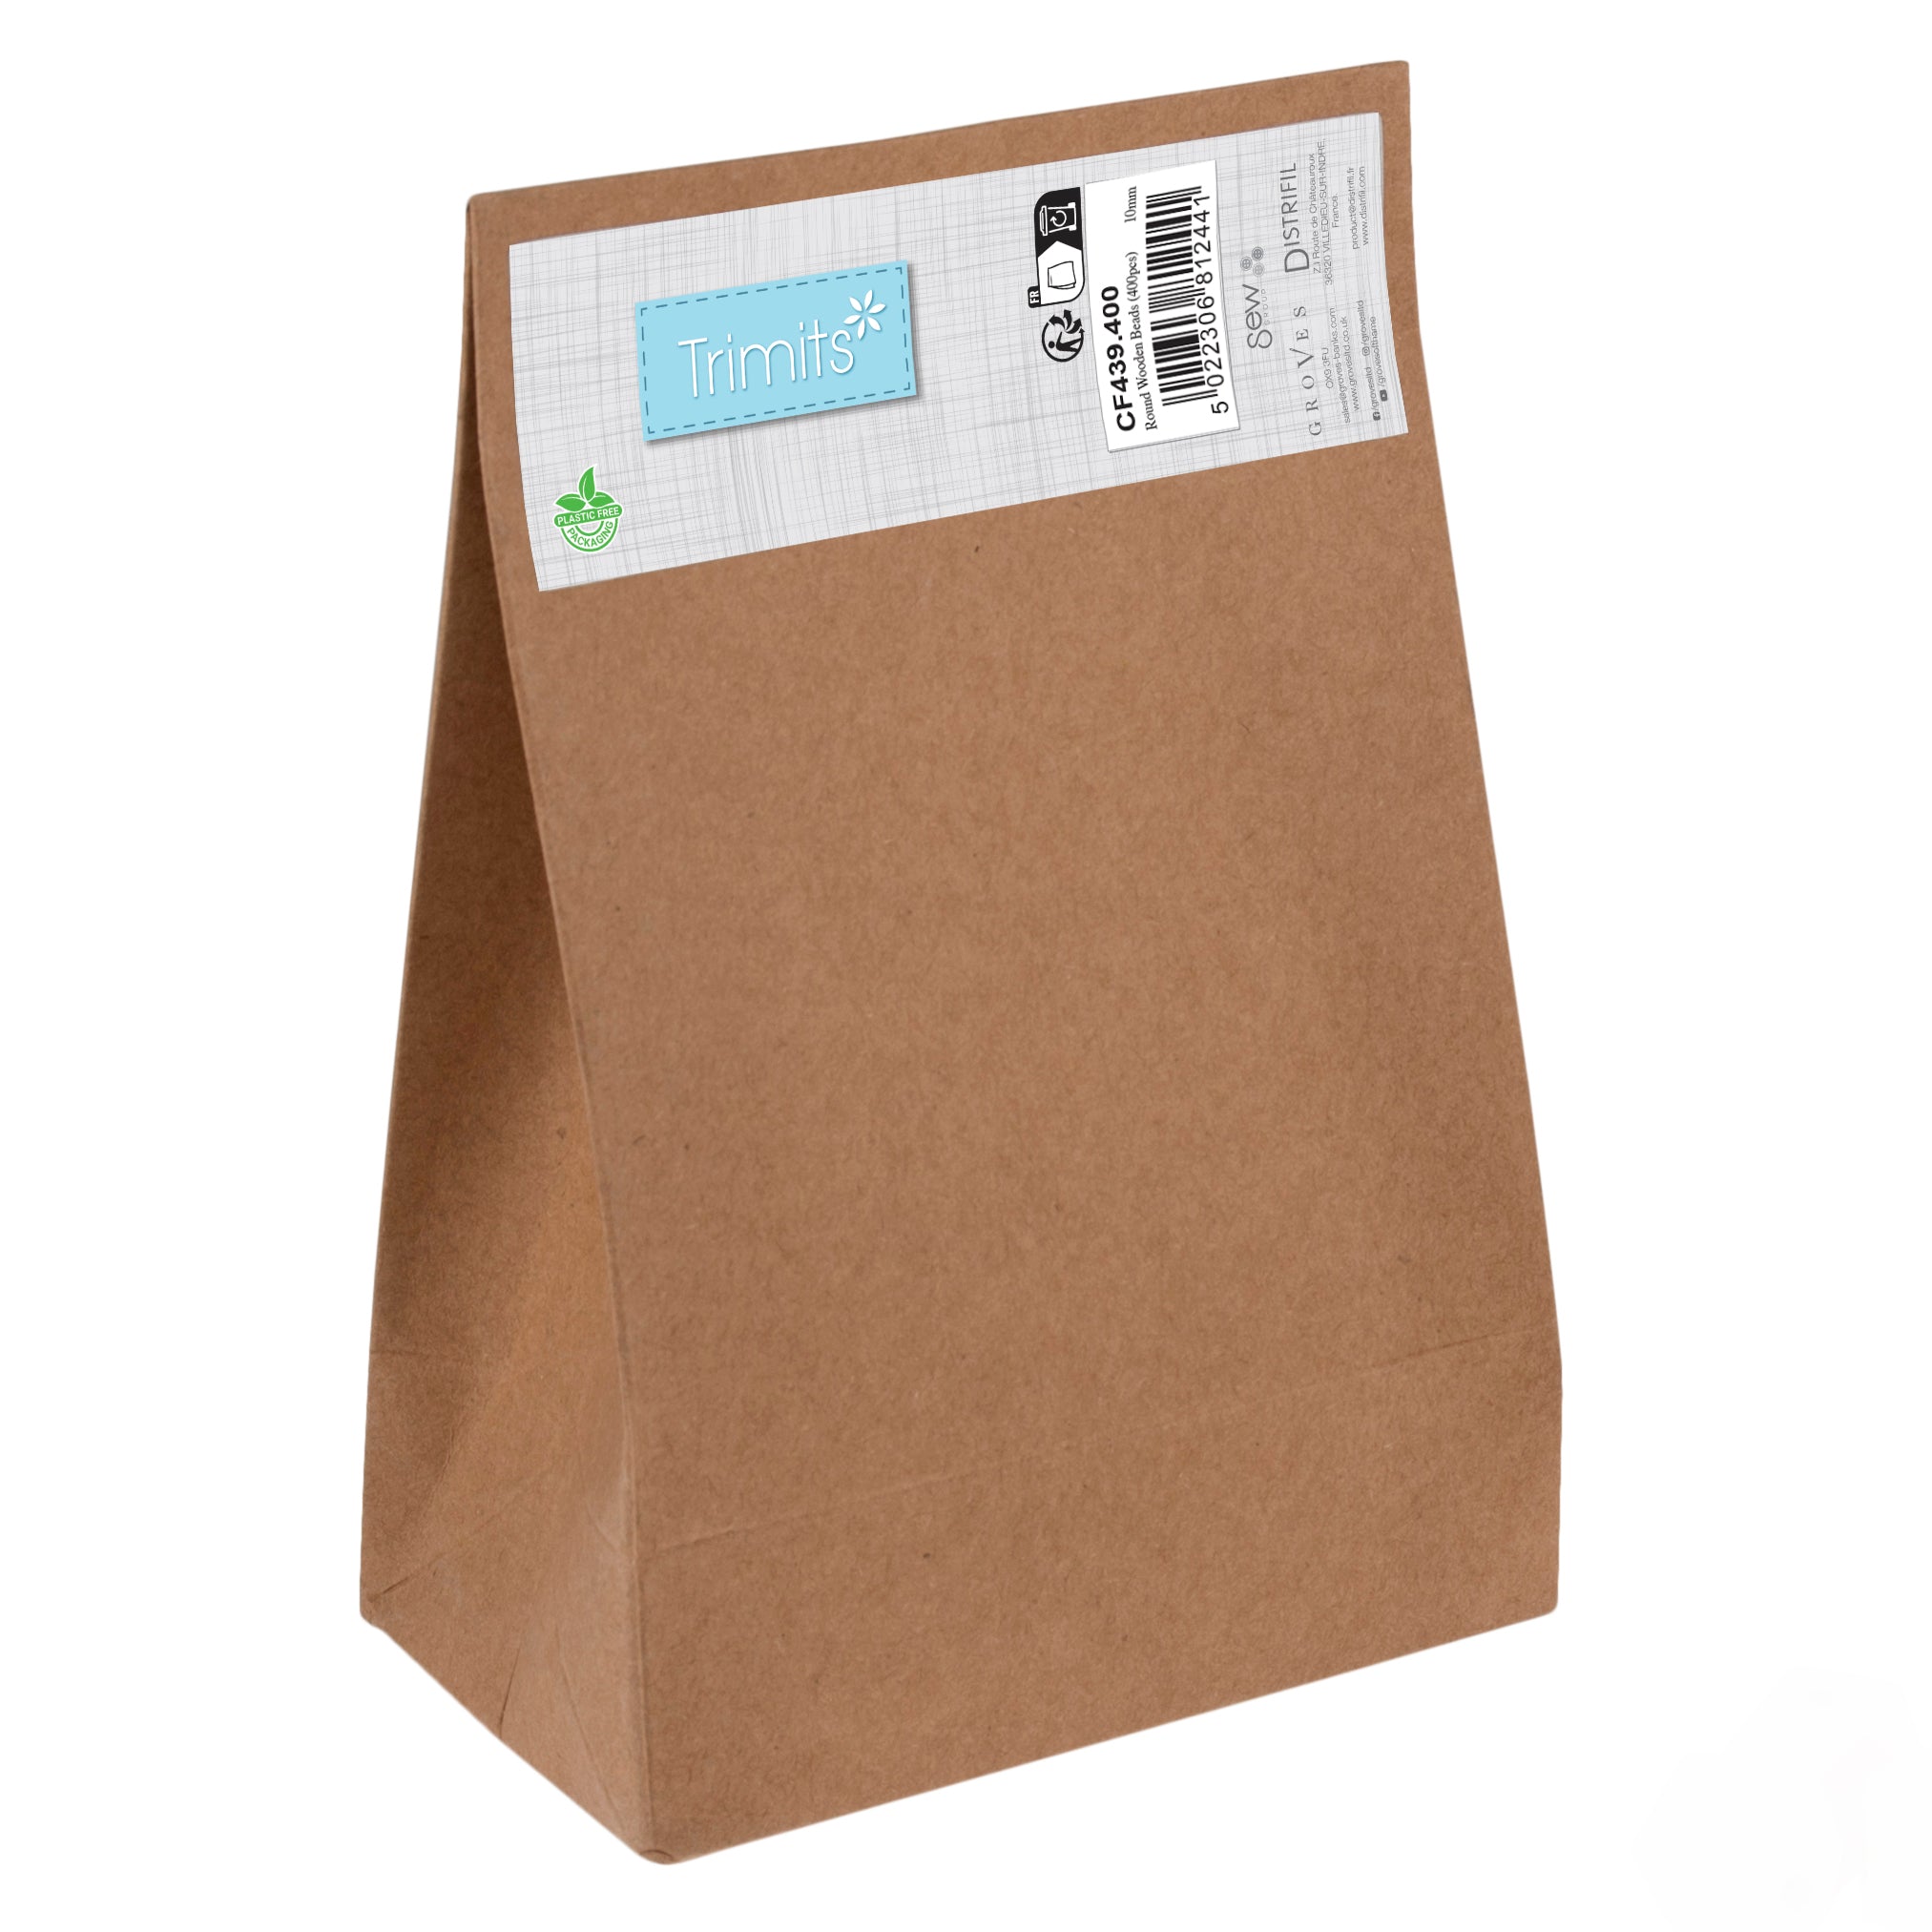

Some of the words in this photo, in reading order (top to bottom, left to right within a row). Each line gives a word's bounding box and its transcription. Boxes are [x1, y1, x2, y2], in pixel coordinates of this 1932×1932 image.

[1124, 186, 1136, 223] 10mm
[1311, 216, 1319, 228] de
[1194, 196, 1213, 285] 812441
[1126, 251, 1139, 303] (400pcs)
[1029, 290, 1040, 303] FR
[1261, 289, 1271, 326] GROUP
[1129, 304, 1142, 341] Beads
[1242, 284, 1273, 348] Sew
[678, 320, 854, 397] Trimits
[1101, 286, 1135, 431] CF439.400
[1197, 296, 1225, 387] 022306
[1321, 347, 1330, 369] 3FU
[1133, 343, 1148, 390] Wooden
[1290, 305, 1322, 436] GROVES
[1323, 369, 1334, 388] OX9
[1139, 393, 1157, 430] Round
[1211, 401, 1229, 414] 5
[557, 510, 595, 526] PLASTIC
[597, 507, 620, 518] FREE
[567, 520, 613, 548] PACKAGING
